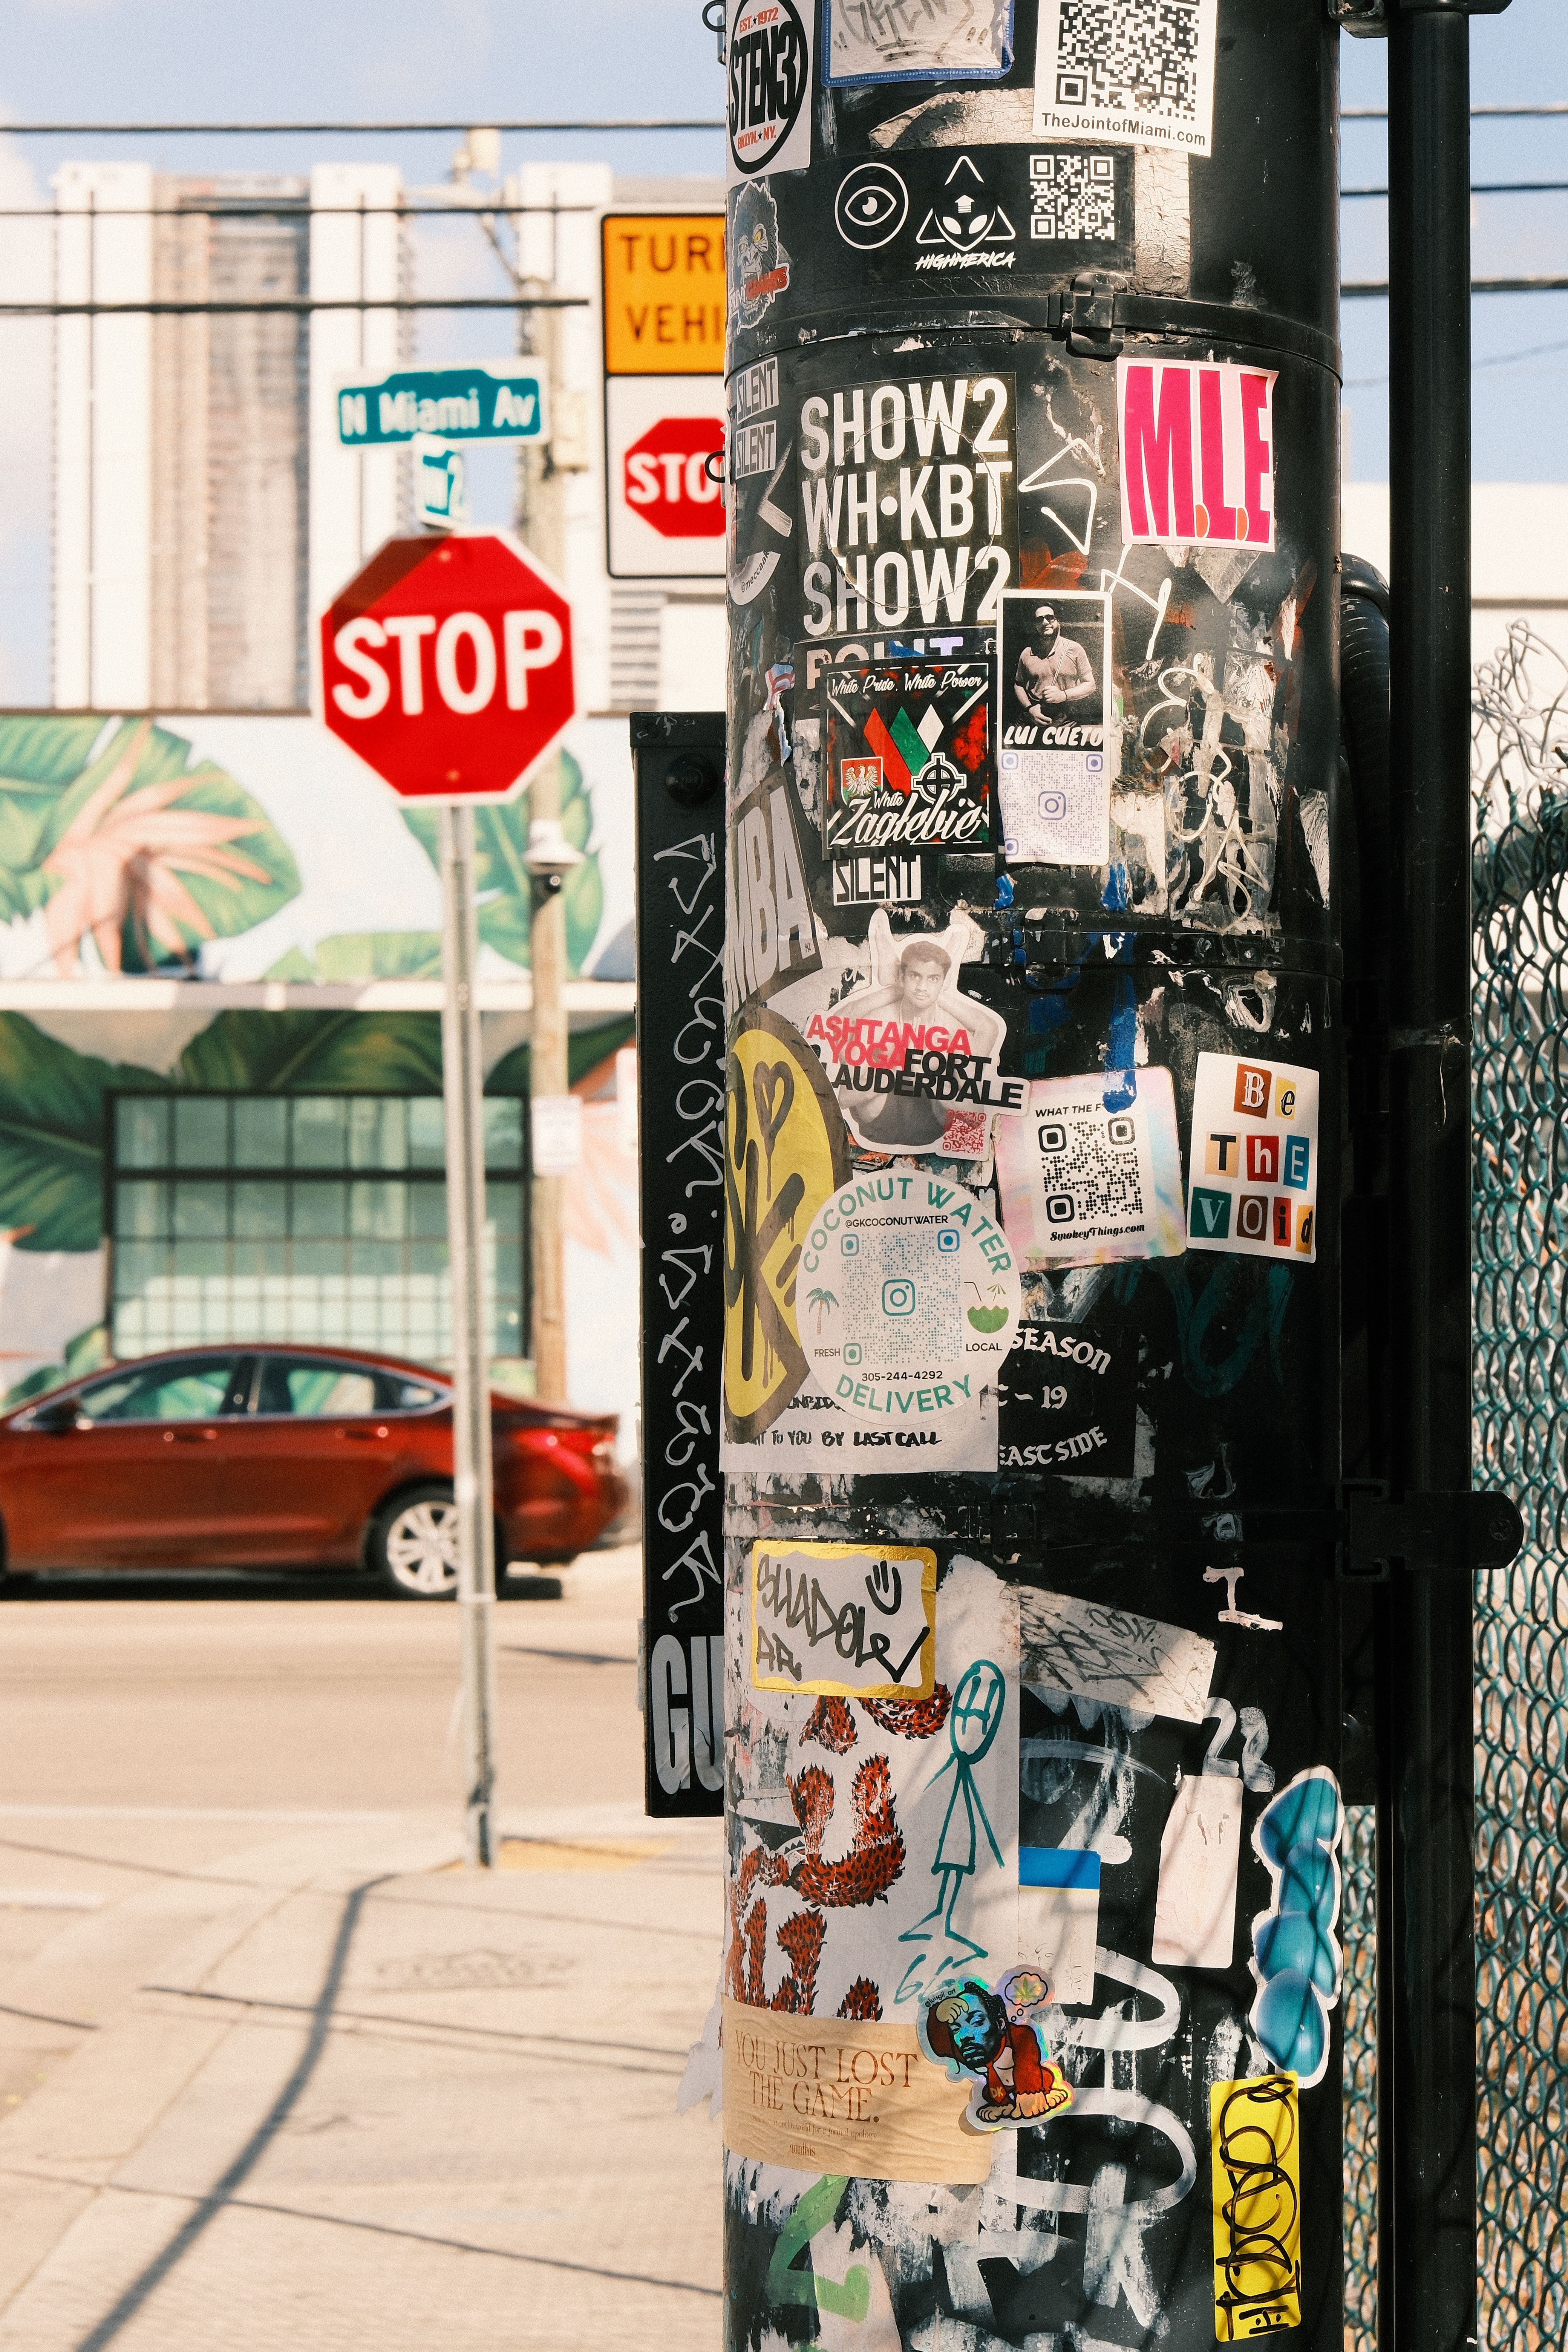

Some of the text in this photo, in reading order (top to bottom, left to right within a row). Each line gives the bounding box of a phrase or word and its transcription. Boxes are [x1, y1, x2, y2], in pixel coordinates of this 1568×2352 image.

[740, 7, 778, 33] EST. 1972
[730, 21, 798, 136] STEN3
[738, 125, 776, 150] BKLYN. NY.
[1041, 112, 1205, 146] TheJointofMiami.com
[620, 234, 726, 273] TUR
[914, 251, 1017, 271] HIGHMERICA
[737, 360, 776, 422] SILENT
[340, 386, 536, 436] N Miami Av
[801, 378, 1008, 470] SHOW2
[737, 424, 775, 476] SILENT
[803, 545, 1011, 636] SHOW2
[332, 610, 564, 720] STOP
[832, 678, 859, 697] White
[905, 672, 936, 691] White
[941, 670, 983, 689] Power
[1003, 725, 1104, 747] LUI CUETO
[874, 790, 905, 809] White
[836, 856, 912, 903] SILENT
[806, 1014, 972, 1055] ASHTANGA
[828, 1036, 905, 1071] YOGA
[903, 1048, 992, 1083] FORT
[1035, 1106, 1069, 1117] WHAT
[1072, 1104, 1092, 1113] THE
[1242, 1071, 1295, 1116] Be
[803, 1177, 1012, 1275] COCONUT WATER
[845, 1215, 948, 1228] @GKCOCONUTWATER
[1050, 1225, 1145, 1241] SmokeyThings.com
[814, 1343, 1003, 1358] FRESH LOCAL
[1011, 1328, 1111, 1374] SEASON
[862, 1371, 943, 1381] 305-244-4292
[835, 1374, 971, 1414] DELIVERY
[1041, 1386, 1067, 1409] 19
[788, 1430, 812, 1446] YOU
[821, 1431, 845, 1447] BY
[853, 1431, 894, 1446] LAST
[895, 1431, 942, 1447] CALL
[1055, 1426, 1107, 1461] SIDE
[925, 1988, 956, 2007] @luisgil_art
[735, 2029, 919, 2088] YOU JUST LOST
[749, 2070, 784, 2111] THE
[792, 2080, 880, 2123] GAME.
[990, 2086, 1004, 2098] DK
